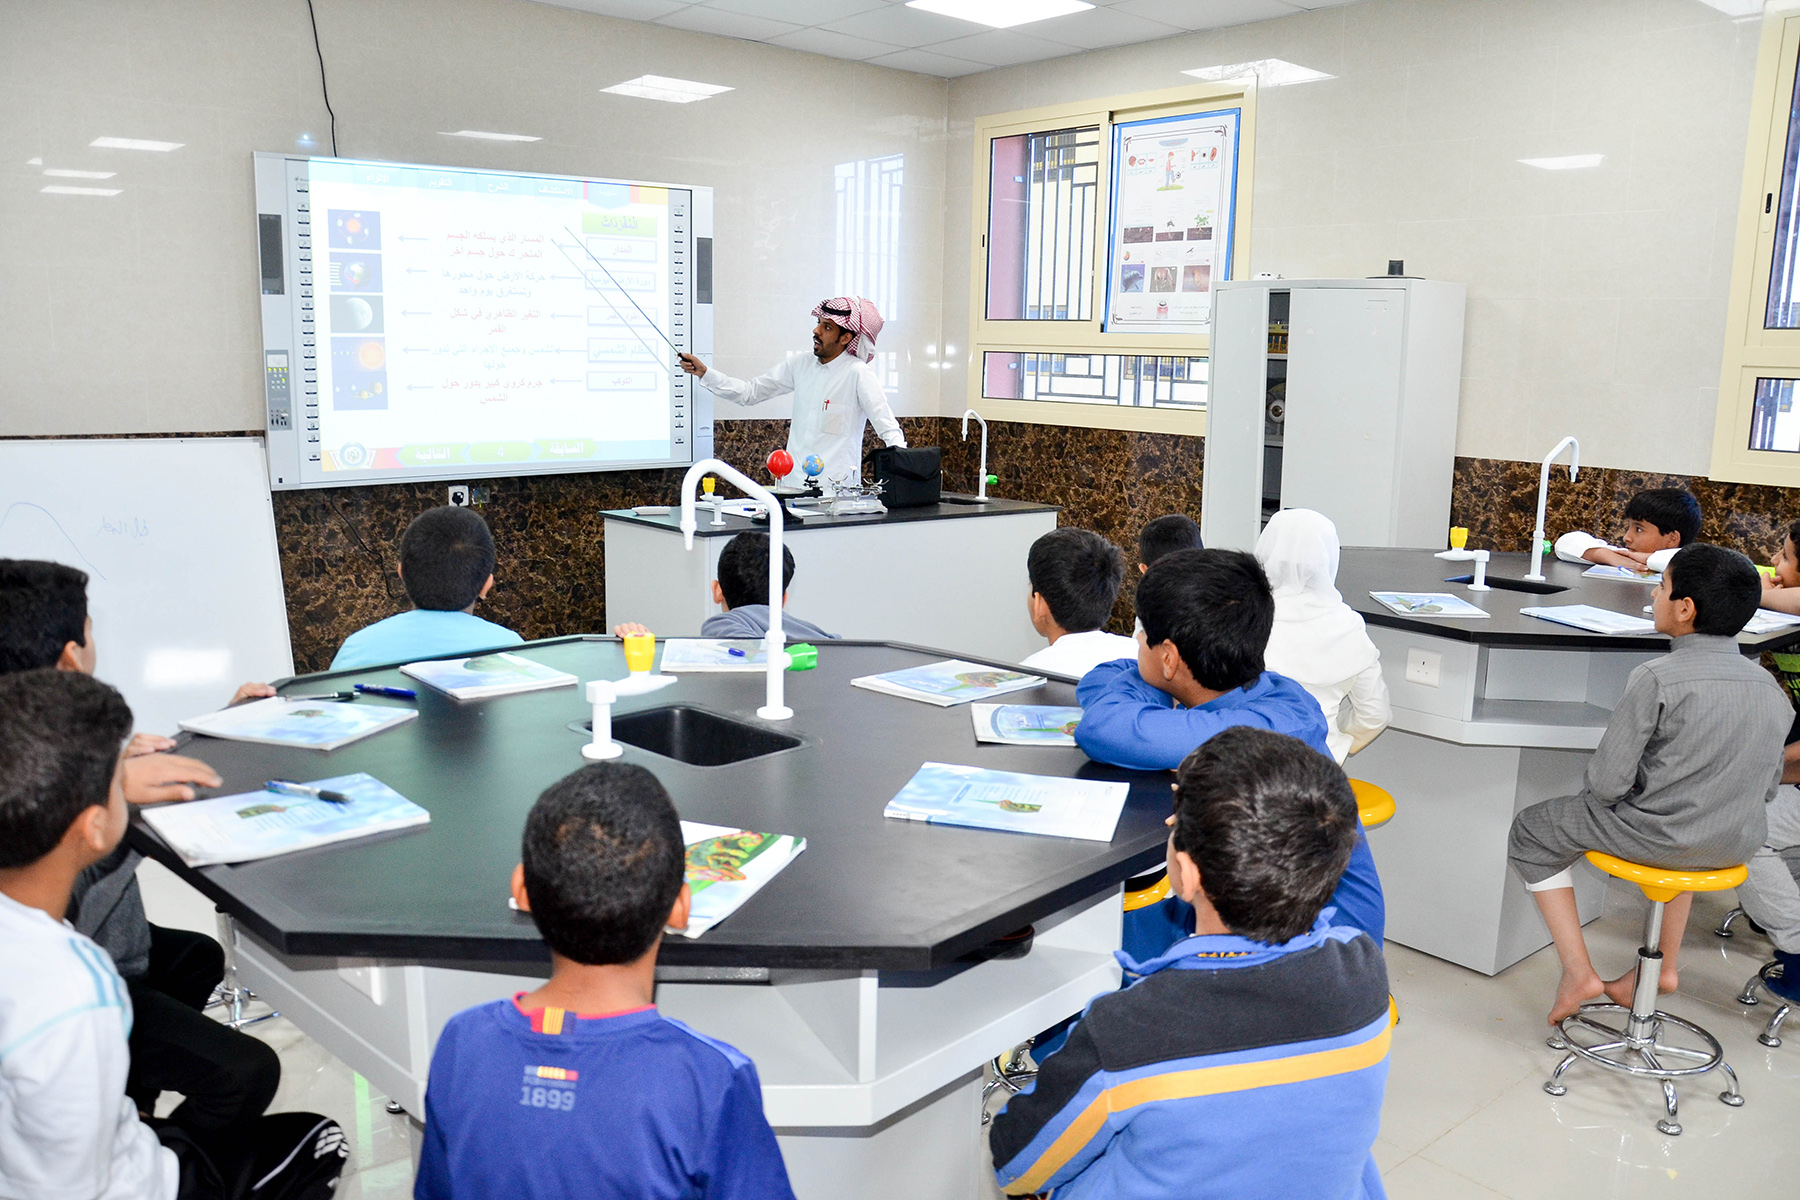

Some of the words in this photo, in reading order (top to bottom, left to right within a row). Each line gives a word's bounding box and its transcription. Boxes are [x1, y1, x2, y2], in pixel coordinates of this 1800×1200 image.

[446, 230, 470, 242] الجسم
[474, 231, 496, 243] يسلكه
[500, 231, 516, 245] الذي
[520, 233, 544, 245] المسار
[467, 249, 485, 259] جسم
[488, 247, 505, 259] حول
[442, 268, 473, 280] محورها
[477, 269, 494, 281] حول
[526, 269, 546, 283] حركة
[459, 286, 477, 297] واحد
[480, 288, 493, 297] يوم
[450, 308, 468, 318] شكل
[488, 323, 506, 335] القمر
[483, 360, 506, 371] حولها
[442, 377, 460, 389] حول
[464, 380, 481, 389] يدور
[485, 378, 500, 389] كبير
[527, 380, 543, 390] جرم
[480, 393, 508, 404] الشمس
[496, 445, 505, 457] 4
[550, 441, 585, 456] السابقة
[415, 447, 450, 464] التالية
[519, 1085, 576, 1112] 1899
